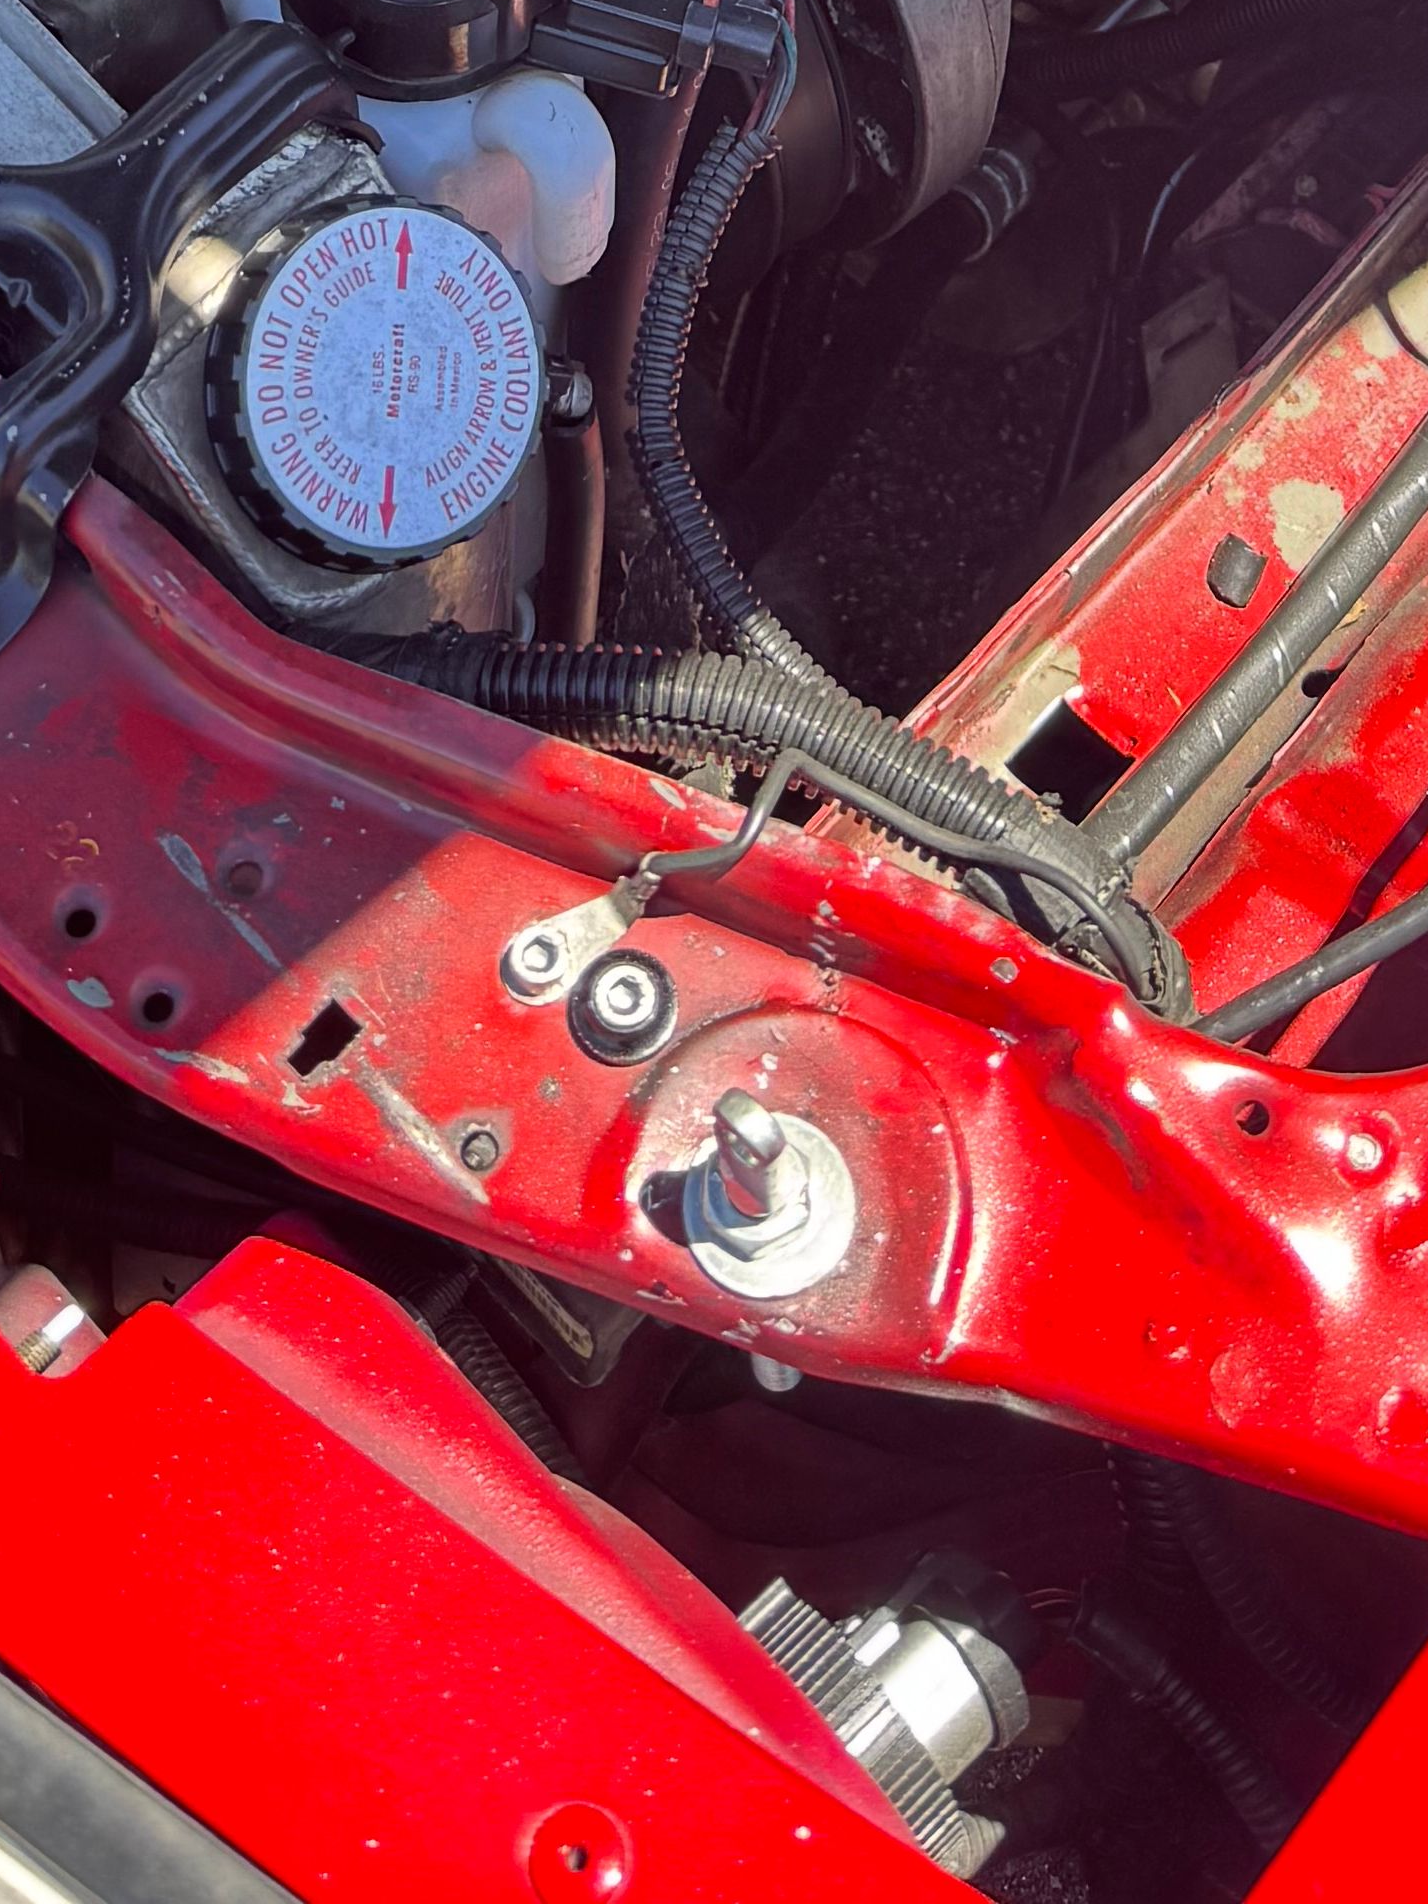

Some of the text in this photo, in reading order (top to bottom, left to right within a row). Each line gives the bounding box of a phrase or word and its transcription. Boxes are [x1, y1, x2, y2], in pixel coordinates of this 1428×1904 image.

[258, 217, 388, 534] WARNING DO NOT OPEN HOT
[293, 261, 377, 487] REFER TO OWNER'S GUIDE
[386, 322, 406, 420] Motorcraft
[425, 269, 497, 489] ALIGN ARROW & VENT TUBE
[434, 345, 449, 413] Assembled
[439, 247, 532, 522] ENGINE COOLANT ONLY
[449, 351, 462, 393] Mexico
